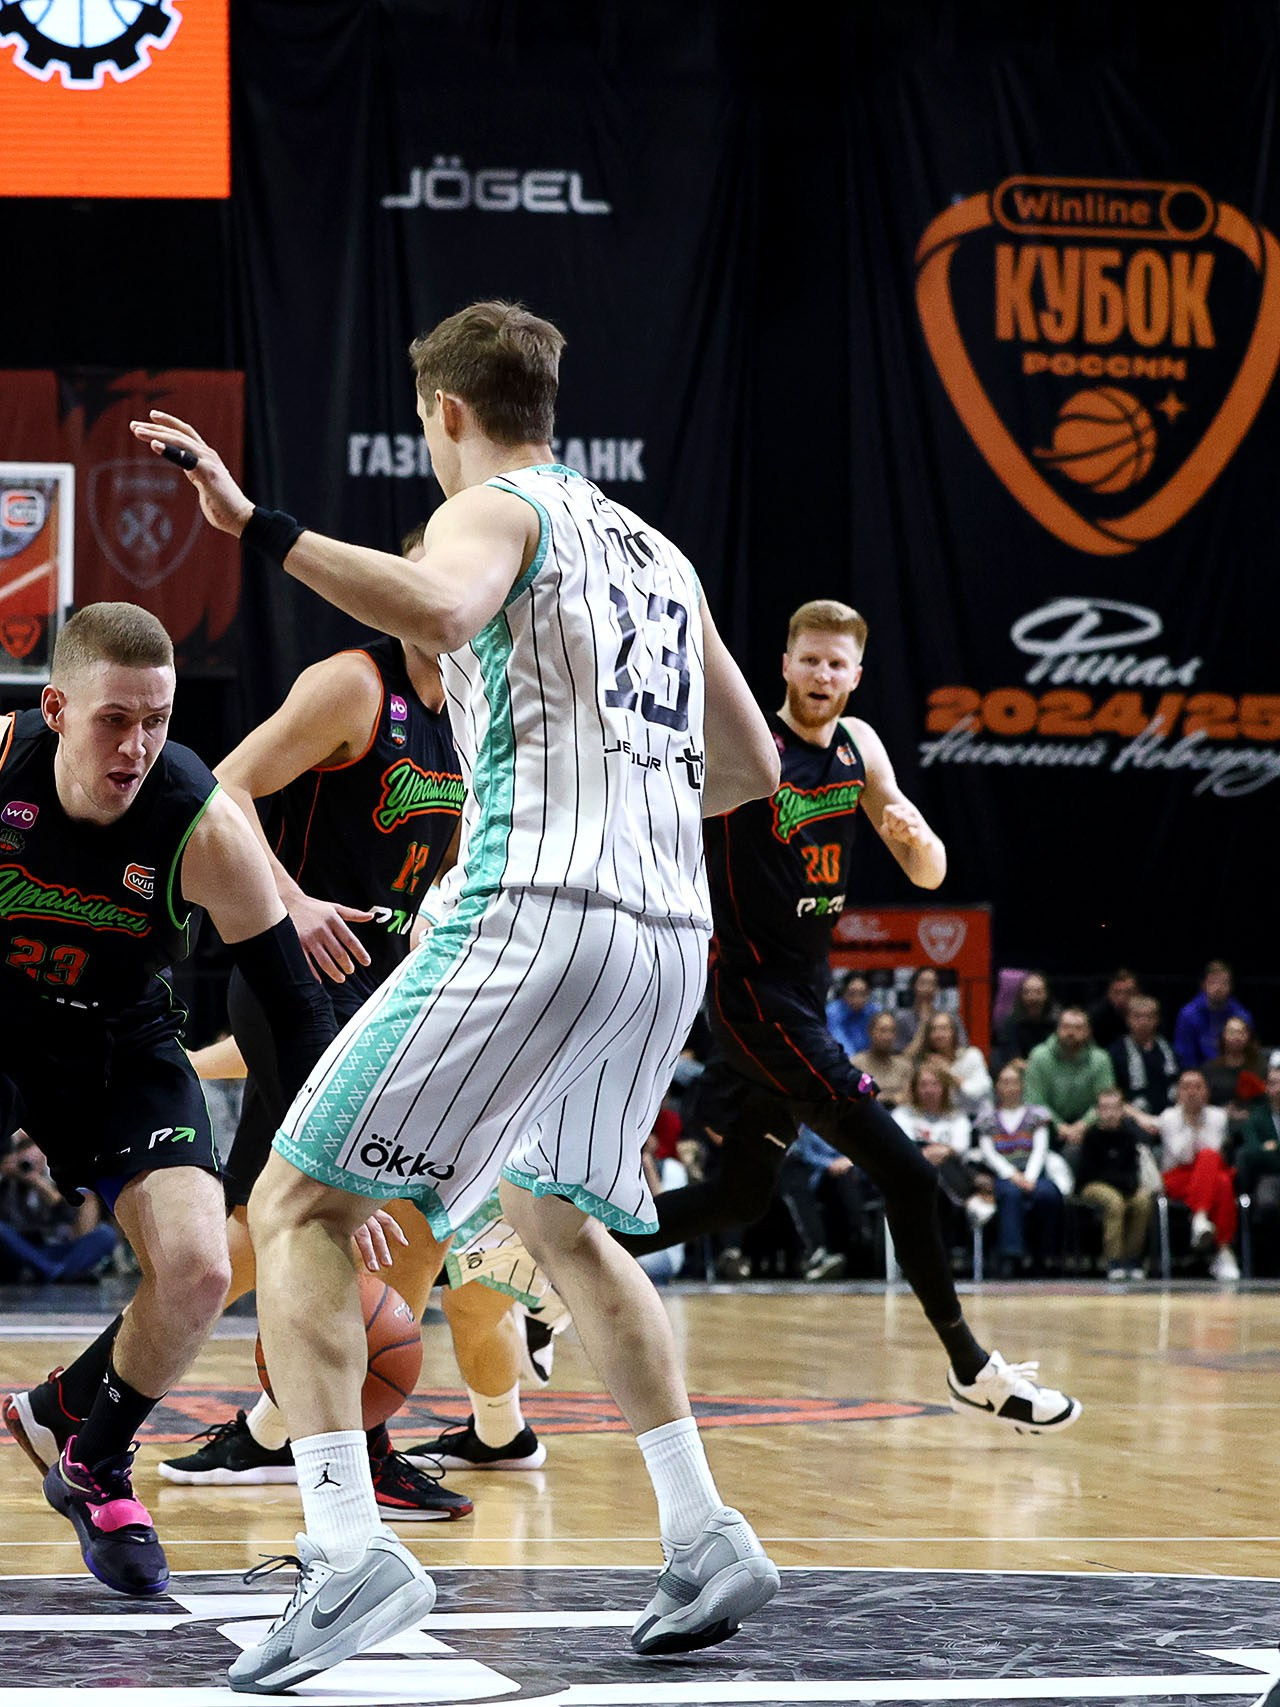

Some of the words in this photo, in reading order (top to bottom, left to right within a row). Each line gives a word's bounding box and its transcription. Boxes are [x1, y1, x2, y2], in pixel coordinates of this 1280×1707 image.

[380, 153, 613, 214] JÖGEL
[1013, 190, 1152, 225] Winline
[994, 244, 1216, 349] КУБОК
[1022, 352, 1187, 380] РОССИИ
[605, 582, 690, 732] 13
[925, 685, 1280, 741] 2024/25
[391, 842, 430, 895] 12
[800, 843, 841, 885] 20
[5, 935, 90, 987] 23
